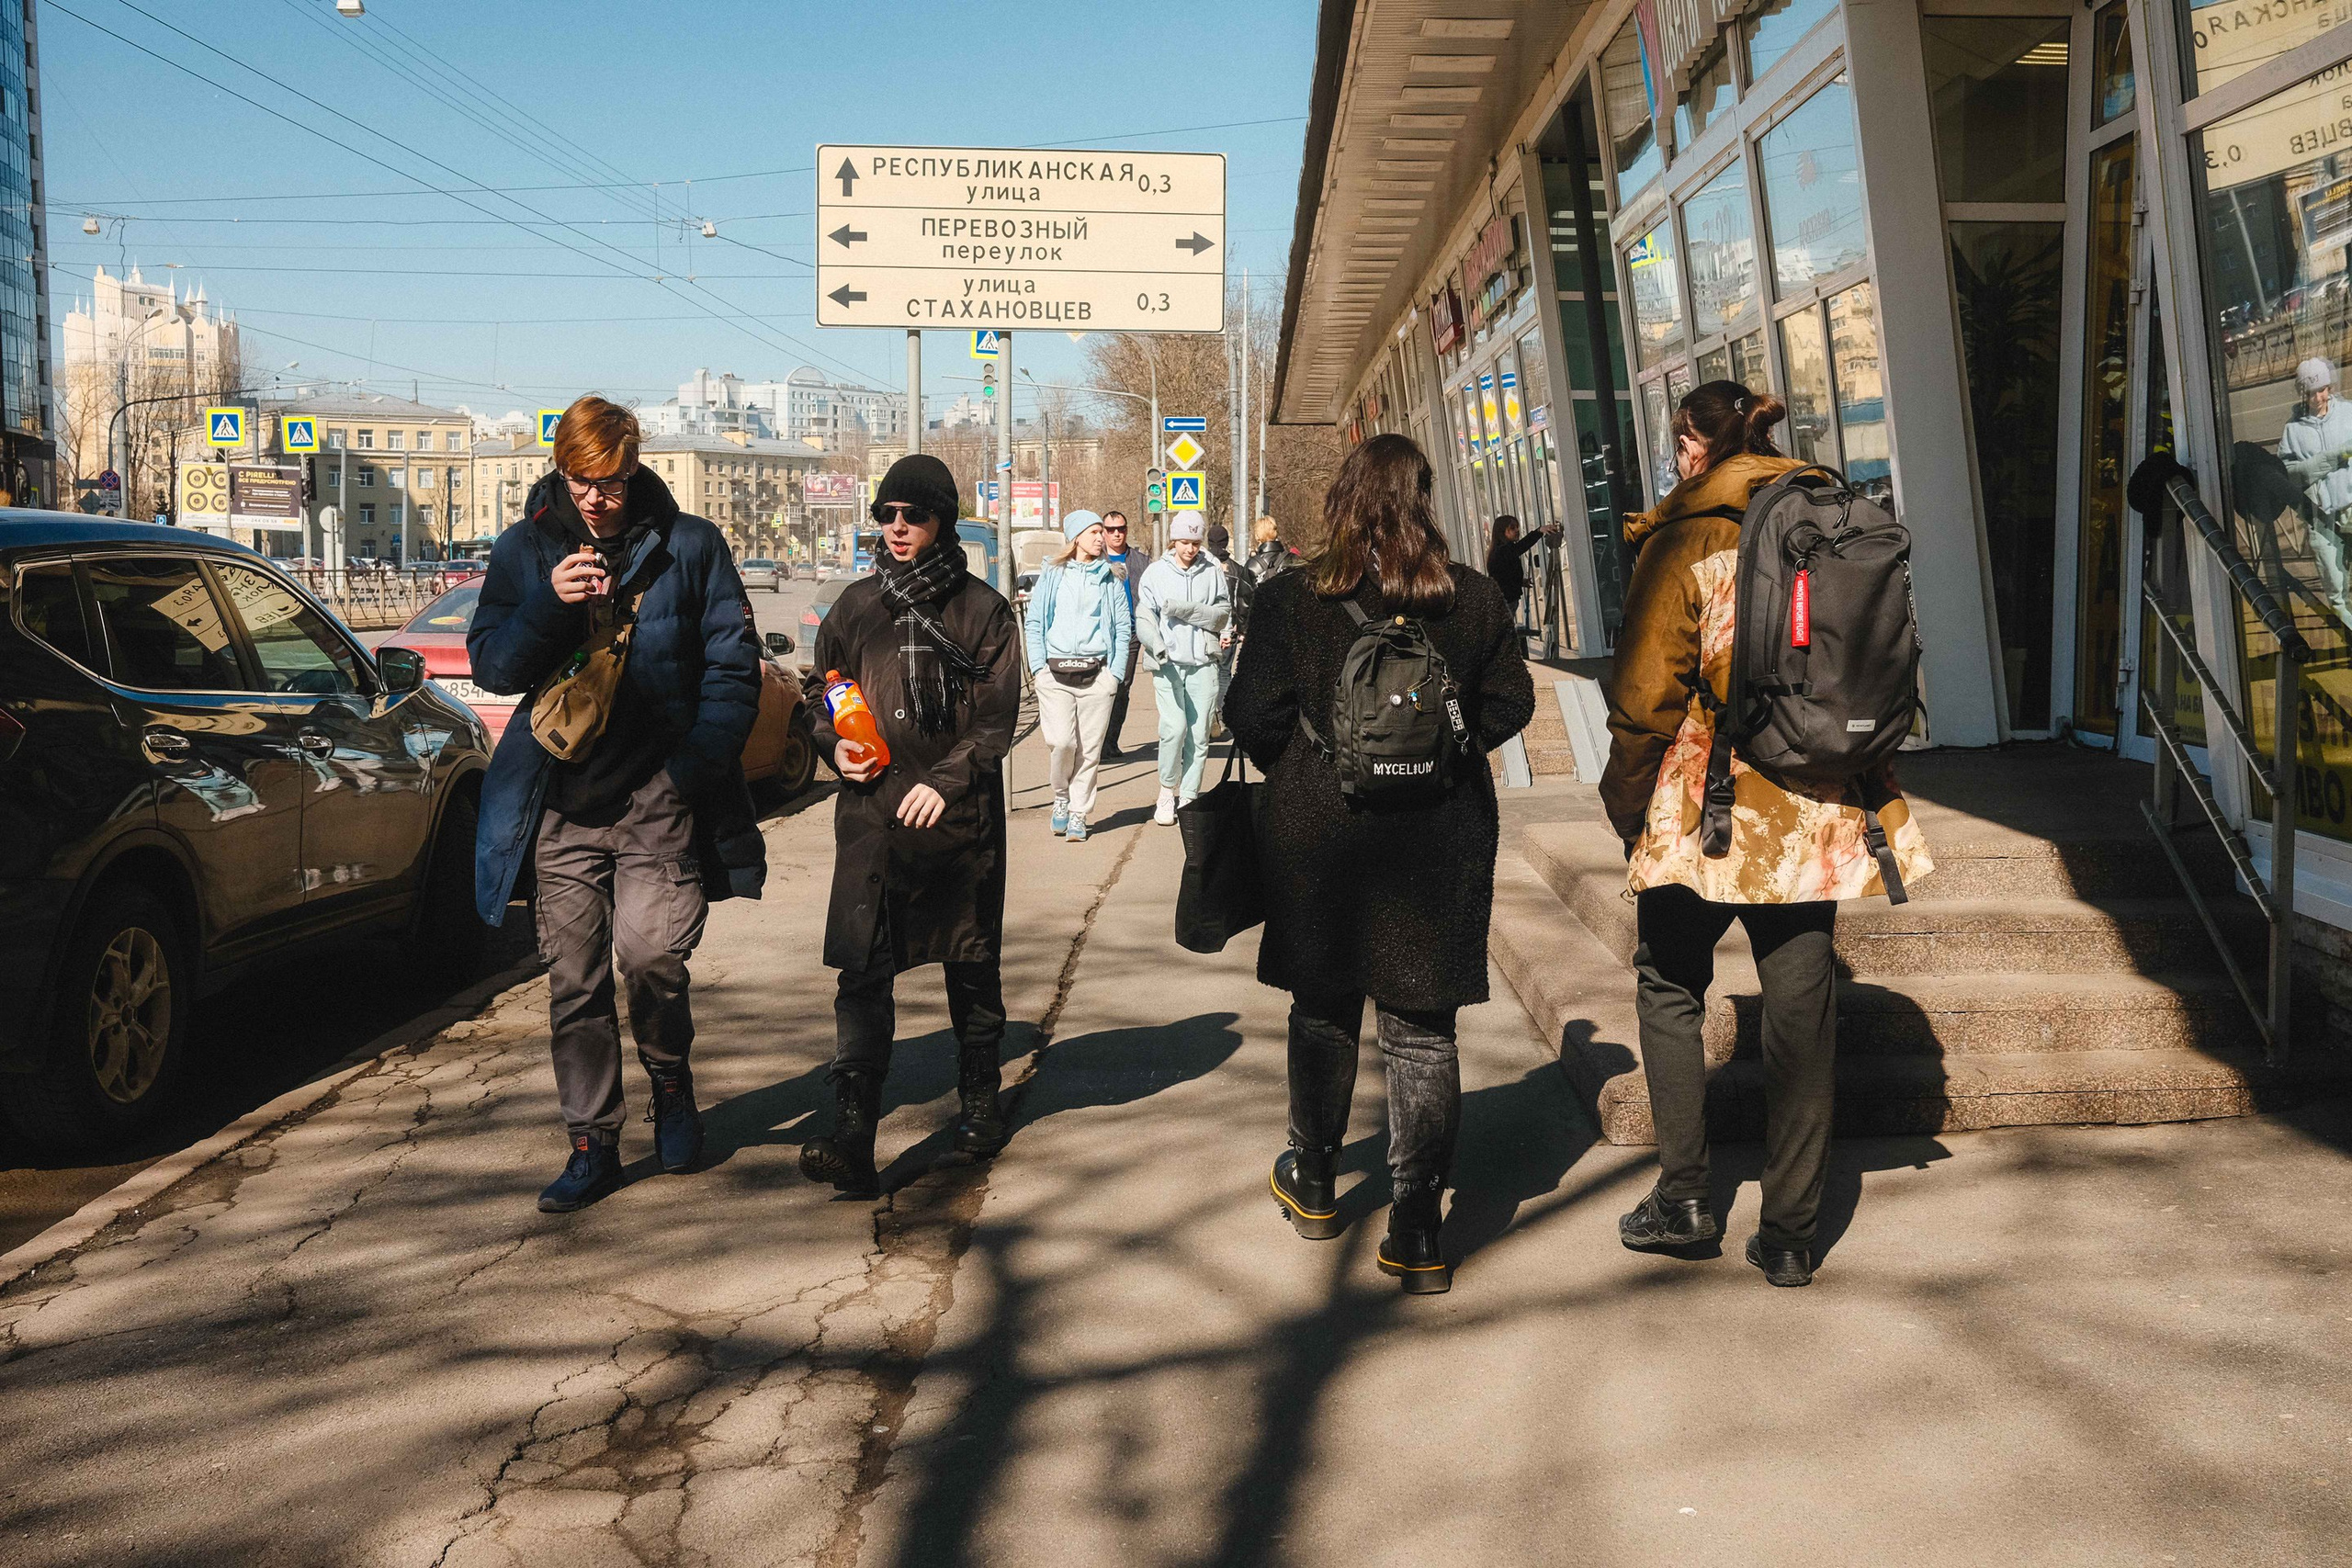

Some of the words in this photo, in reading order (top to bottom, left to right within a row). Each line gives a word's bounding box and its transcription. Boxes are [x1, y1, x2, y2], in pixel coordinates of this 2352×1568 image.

[873, 156, 1135, 182] РЕСПУБЛИКАНСКАЯ
[1137, 174, 1171, 195] 0,3
[966, 184, 1041, 204] улица
[922, 217, 1089, 241] ПЕРЕВОЗНЫЙ
[943, 243, 1063, 264] переулок
[963, 277, 1036, 297] улица
[906, 299, 1091, 322] СТАХАНОВЦЕВ
[1136, 292, 1170, 313] 0,3
[245, 471, 276, 479] PIRELLI
[1796, 580, 1804, 602] REMOVE
[1796, 602, 1804, 622] BEFORE
[1796, 622, 1804, 642] FLIGHT
[1057, 660, 1089, 669] adidas
[1374, 761, 1434, 775] MYCELIUM
